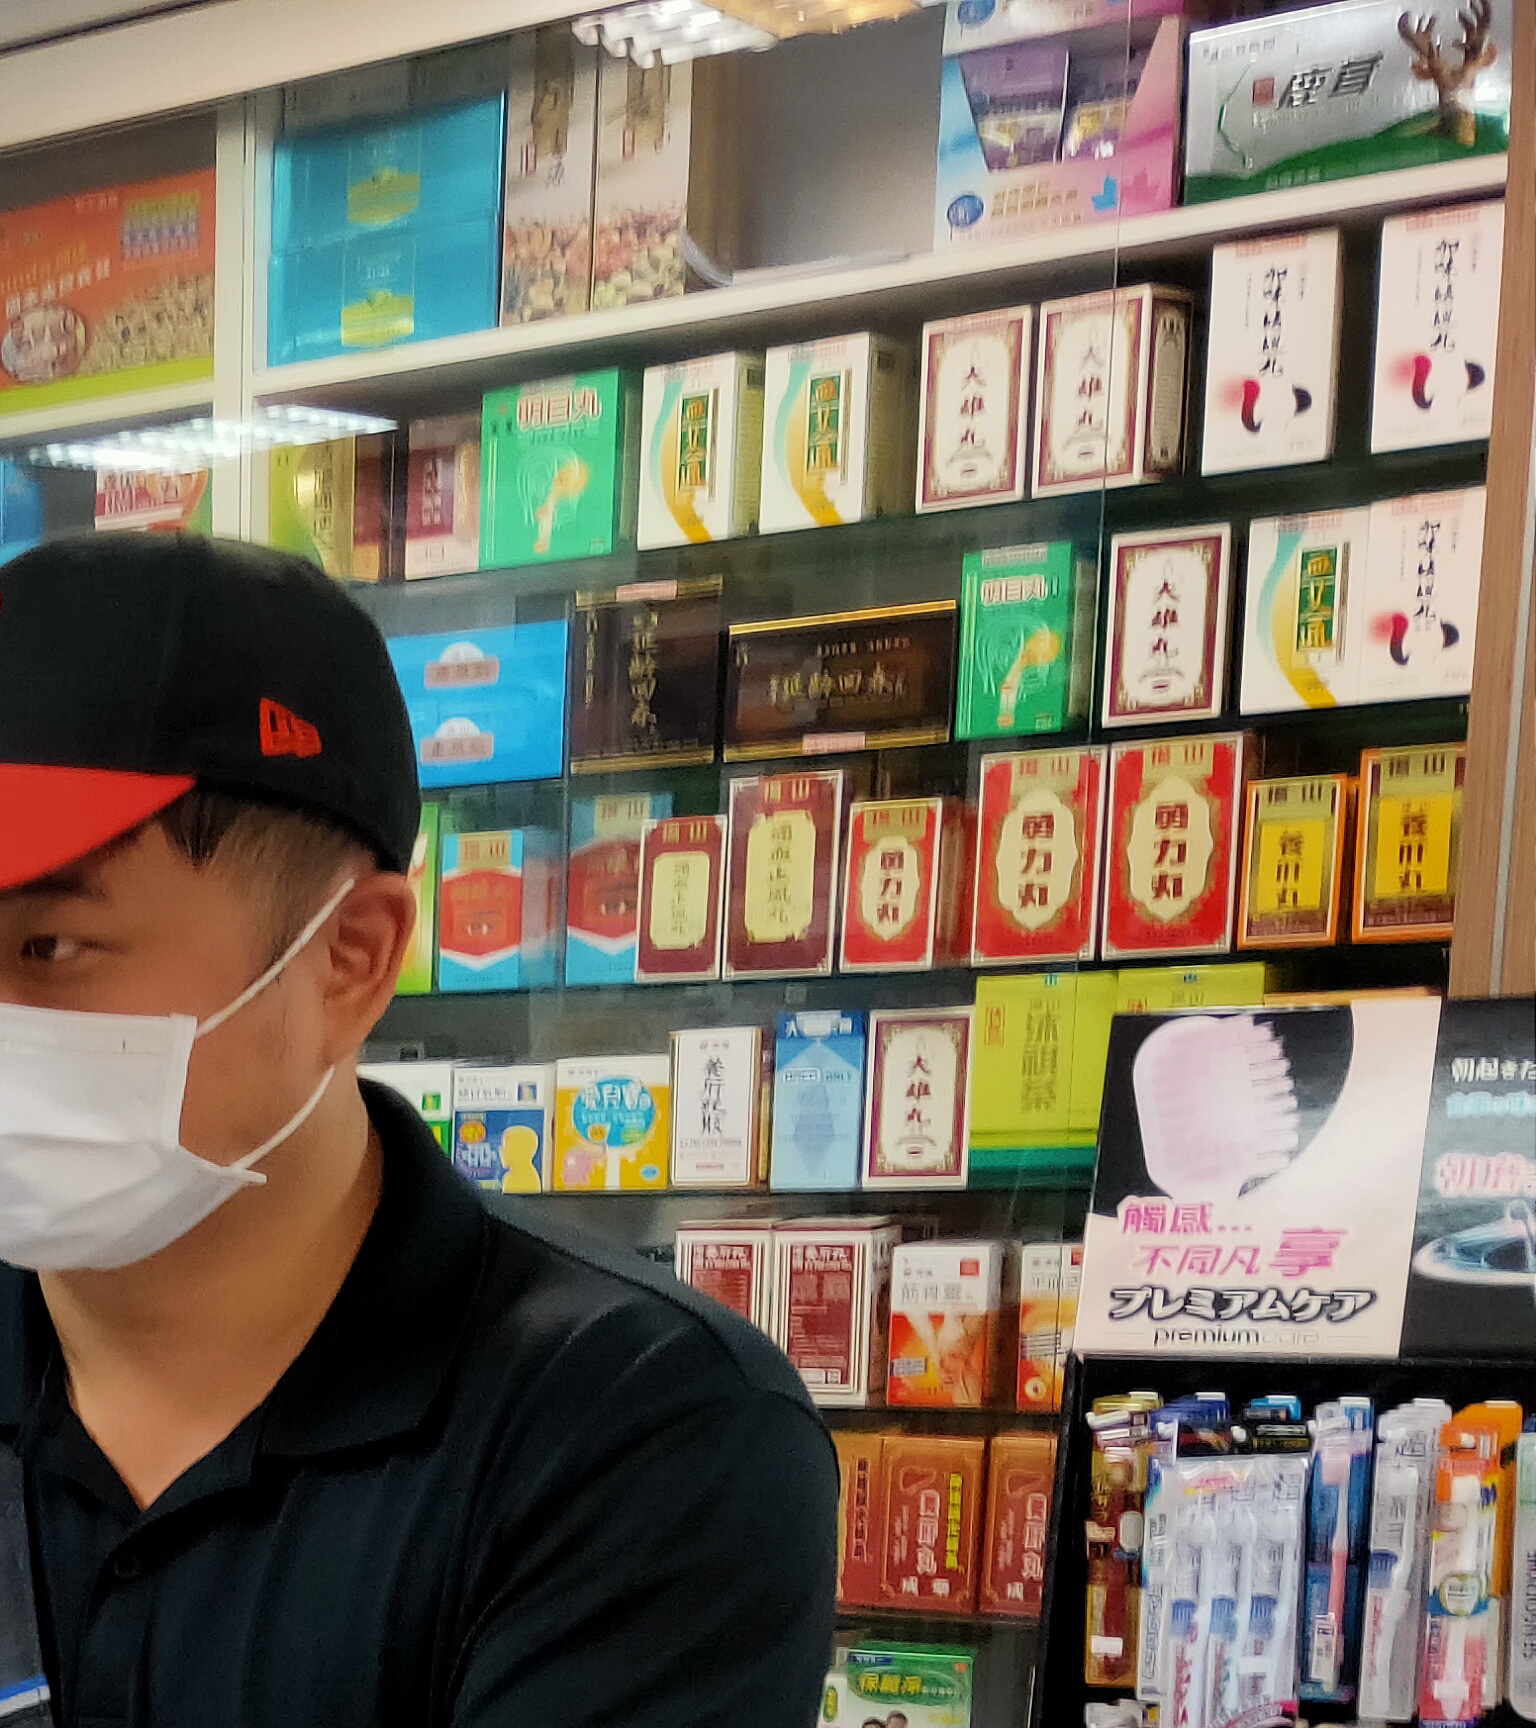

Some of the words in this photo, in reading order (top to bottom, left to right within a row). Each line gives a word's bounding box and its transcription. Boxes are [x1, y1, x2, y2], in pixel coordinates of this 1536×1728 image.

[1137, 1227, 1349, 1278] 不同凡享
[1111, 1285, 1376, 1322] プレミアムケア
